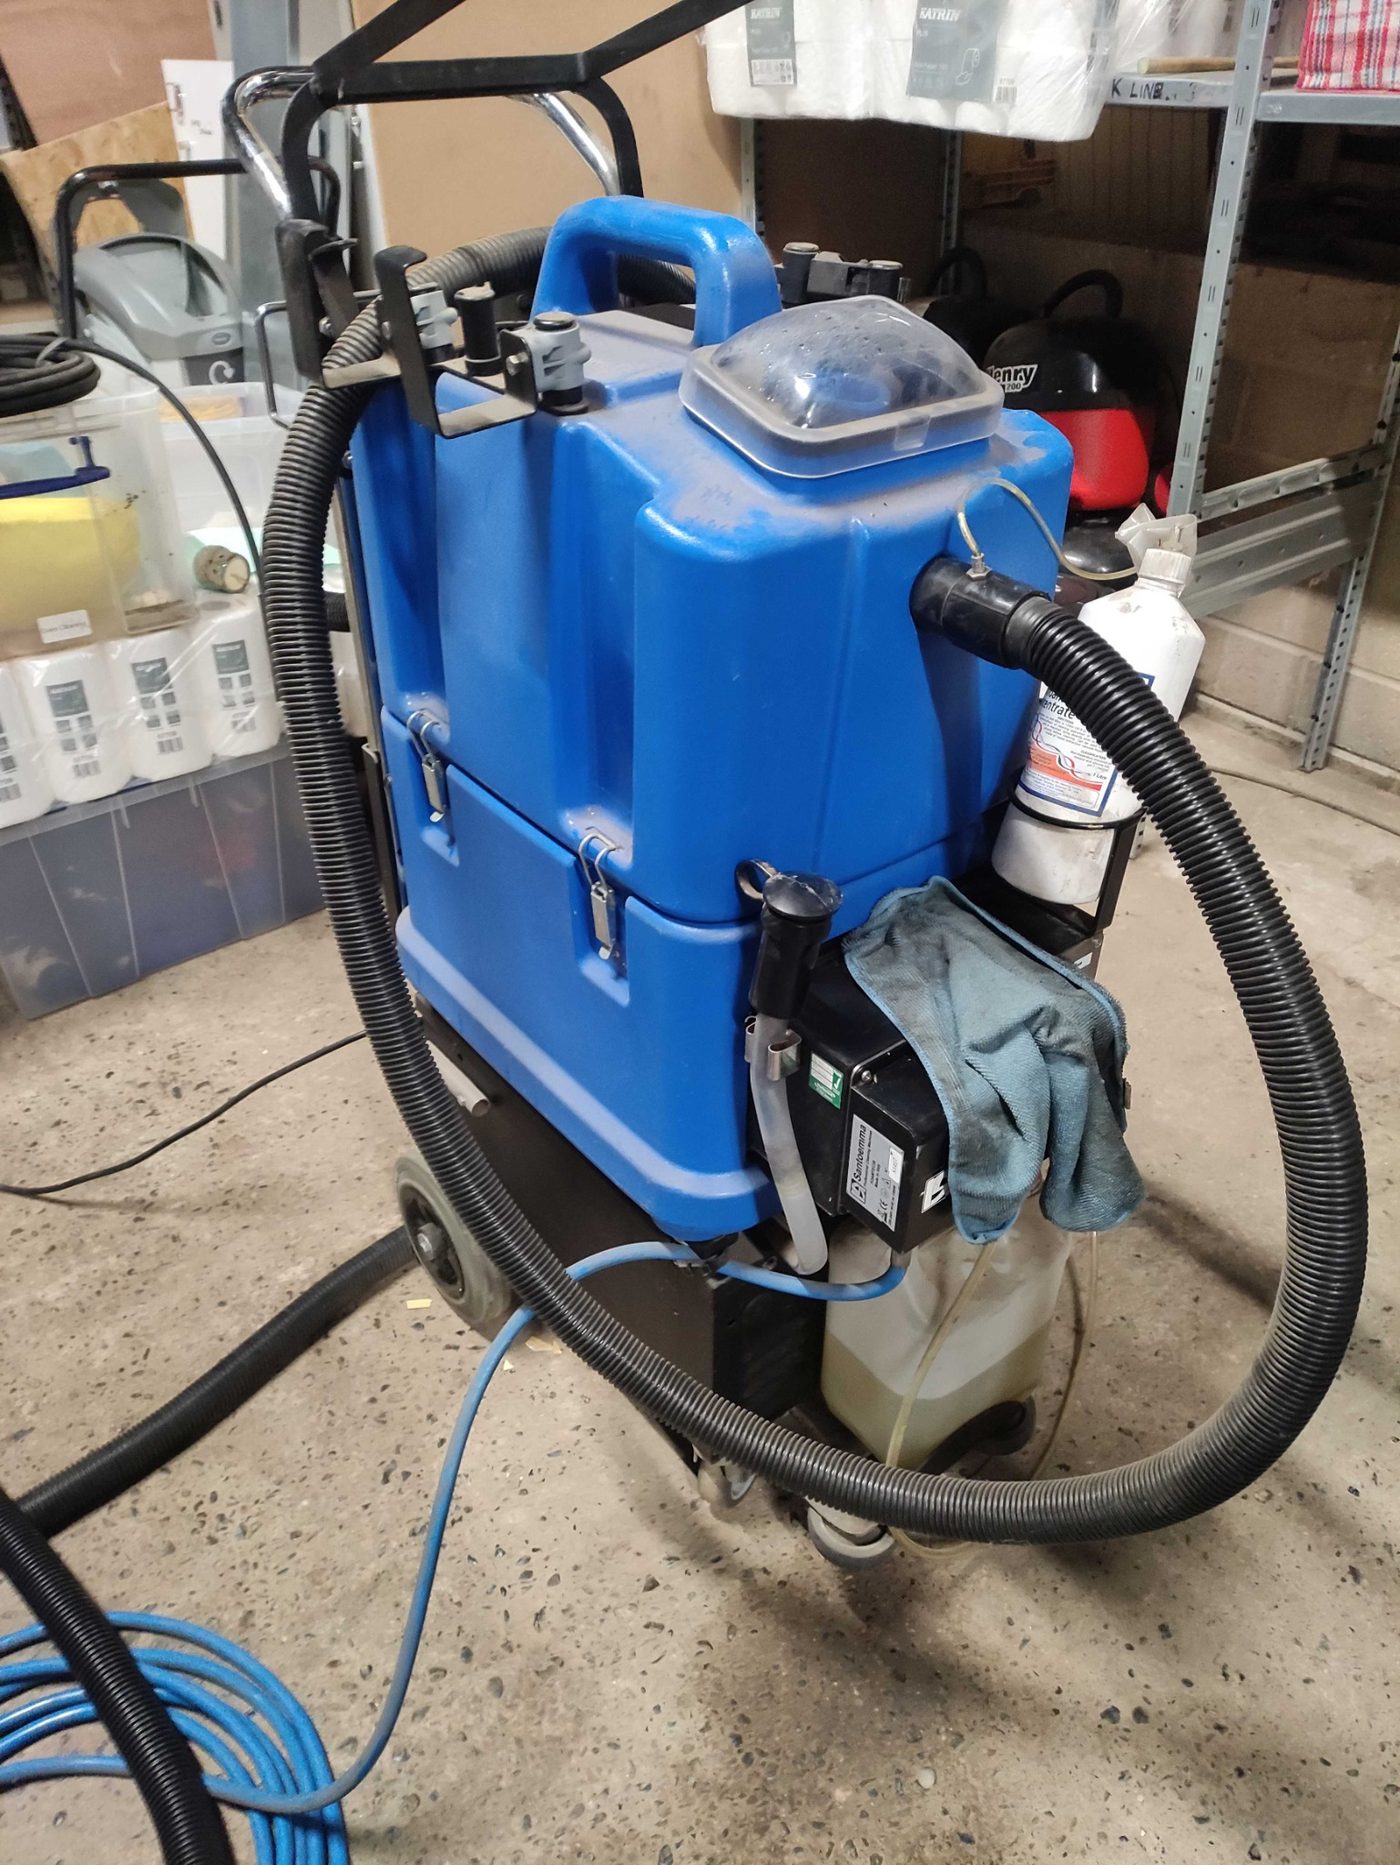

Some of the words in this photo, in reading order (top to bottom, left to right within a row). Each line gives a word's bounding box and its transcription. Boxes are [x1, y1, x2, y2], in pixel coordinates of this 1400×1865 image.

[920, 8, 961, 21] KATRIN
[1041, 700, 1075, 720] entrate
[854, 1124, 867, 1182] Santoemma
